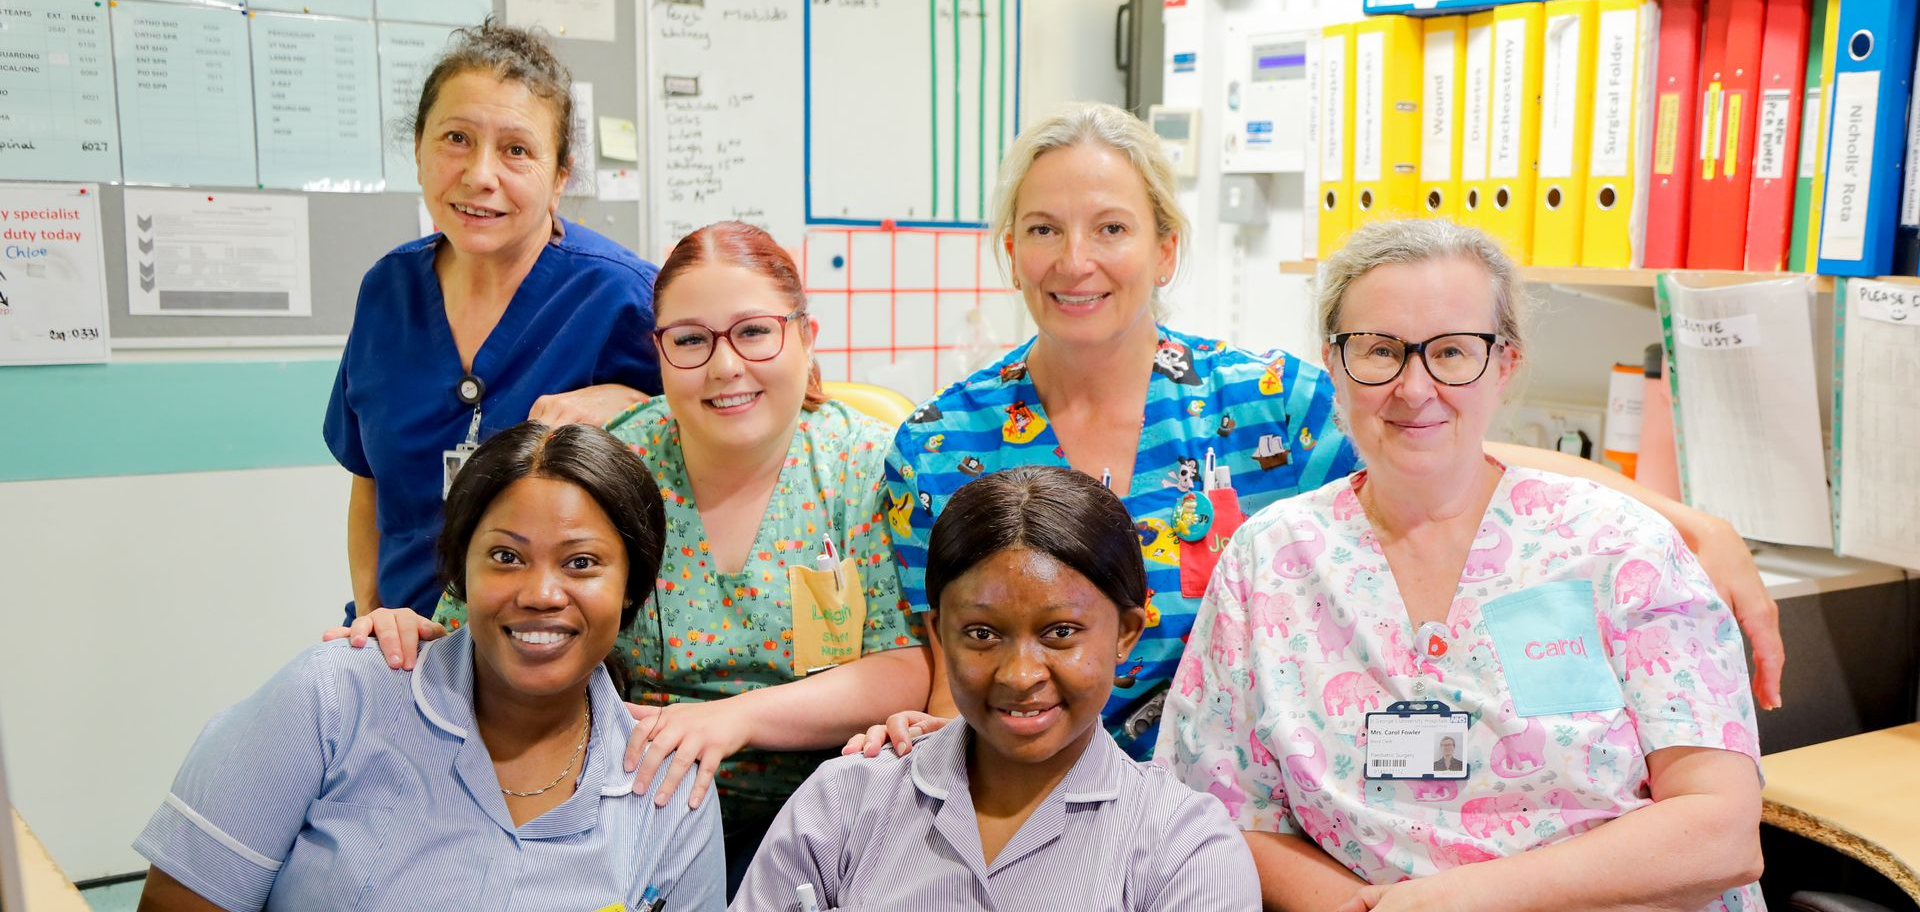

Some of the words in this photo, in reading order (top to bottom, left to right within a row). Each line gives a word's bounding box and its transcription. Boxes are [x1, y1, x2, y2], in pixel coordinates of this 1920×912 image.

[4, 9, 32, 17] TEAMS
[1609, 34, 1623, 87] Folder
[1433, 75, 1444, 135] Wound
[1471, 67, 1482, 142] Diabetes
[1499, 39, 1515, 160] Tracheostomy
[1604, 91, 1620, 156] Surgical
[81, 142, 108, 151] 6027
[1840, 183, 1856, 222] Rota
[1, 210, 9, 221] y
[13, 208, 80, 221] specialist
[3, 228, 36, 242] duty
[41, 229, 81, 242] today
[6, 245, 47, 260] Chloe
[1860, 287, 1904, 305] PLEASE
[1701, 335, 1742, 346] LISTS
[811, 604, 852, 625] Leigh
[822, 632, 849, 643] Staff
[821, 645, 852, 656] Nurse
[1525, 637, 1588, 660] Carol
